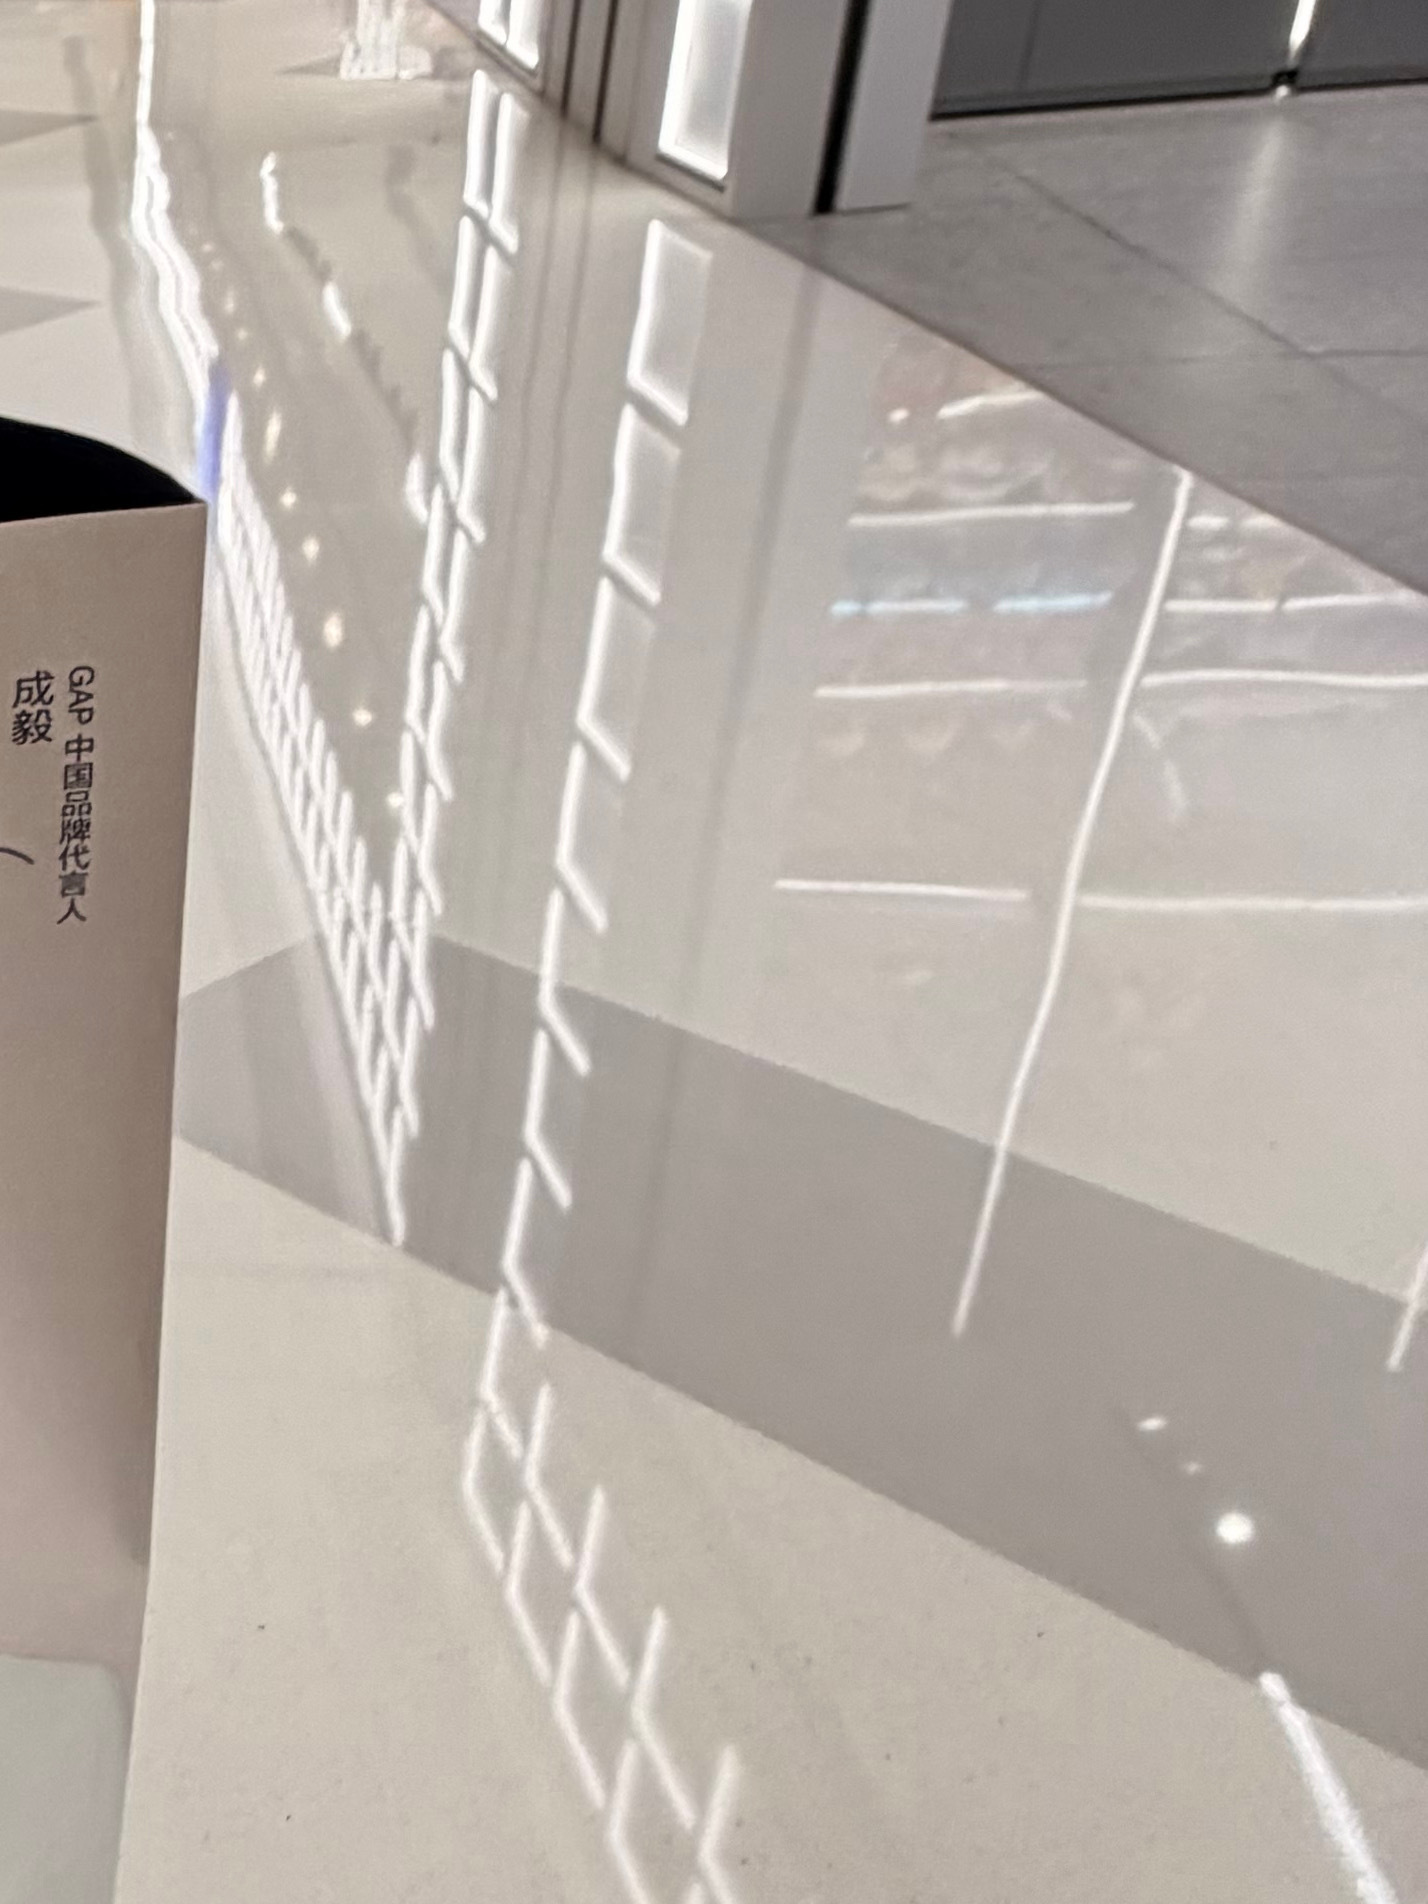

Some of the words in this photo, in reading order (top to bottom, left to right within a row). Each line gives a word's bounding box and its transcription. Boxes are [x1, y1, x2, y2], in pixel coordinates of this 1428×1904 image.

[11, 669, 55, 746] 成毅
[67, 665, 95, 726] GAP
[56, 733, 94, 925] 中国品牌代言人
